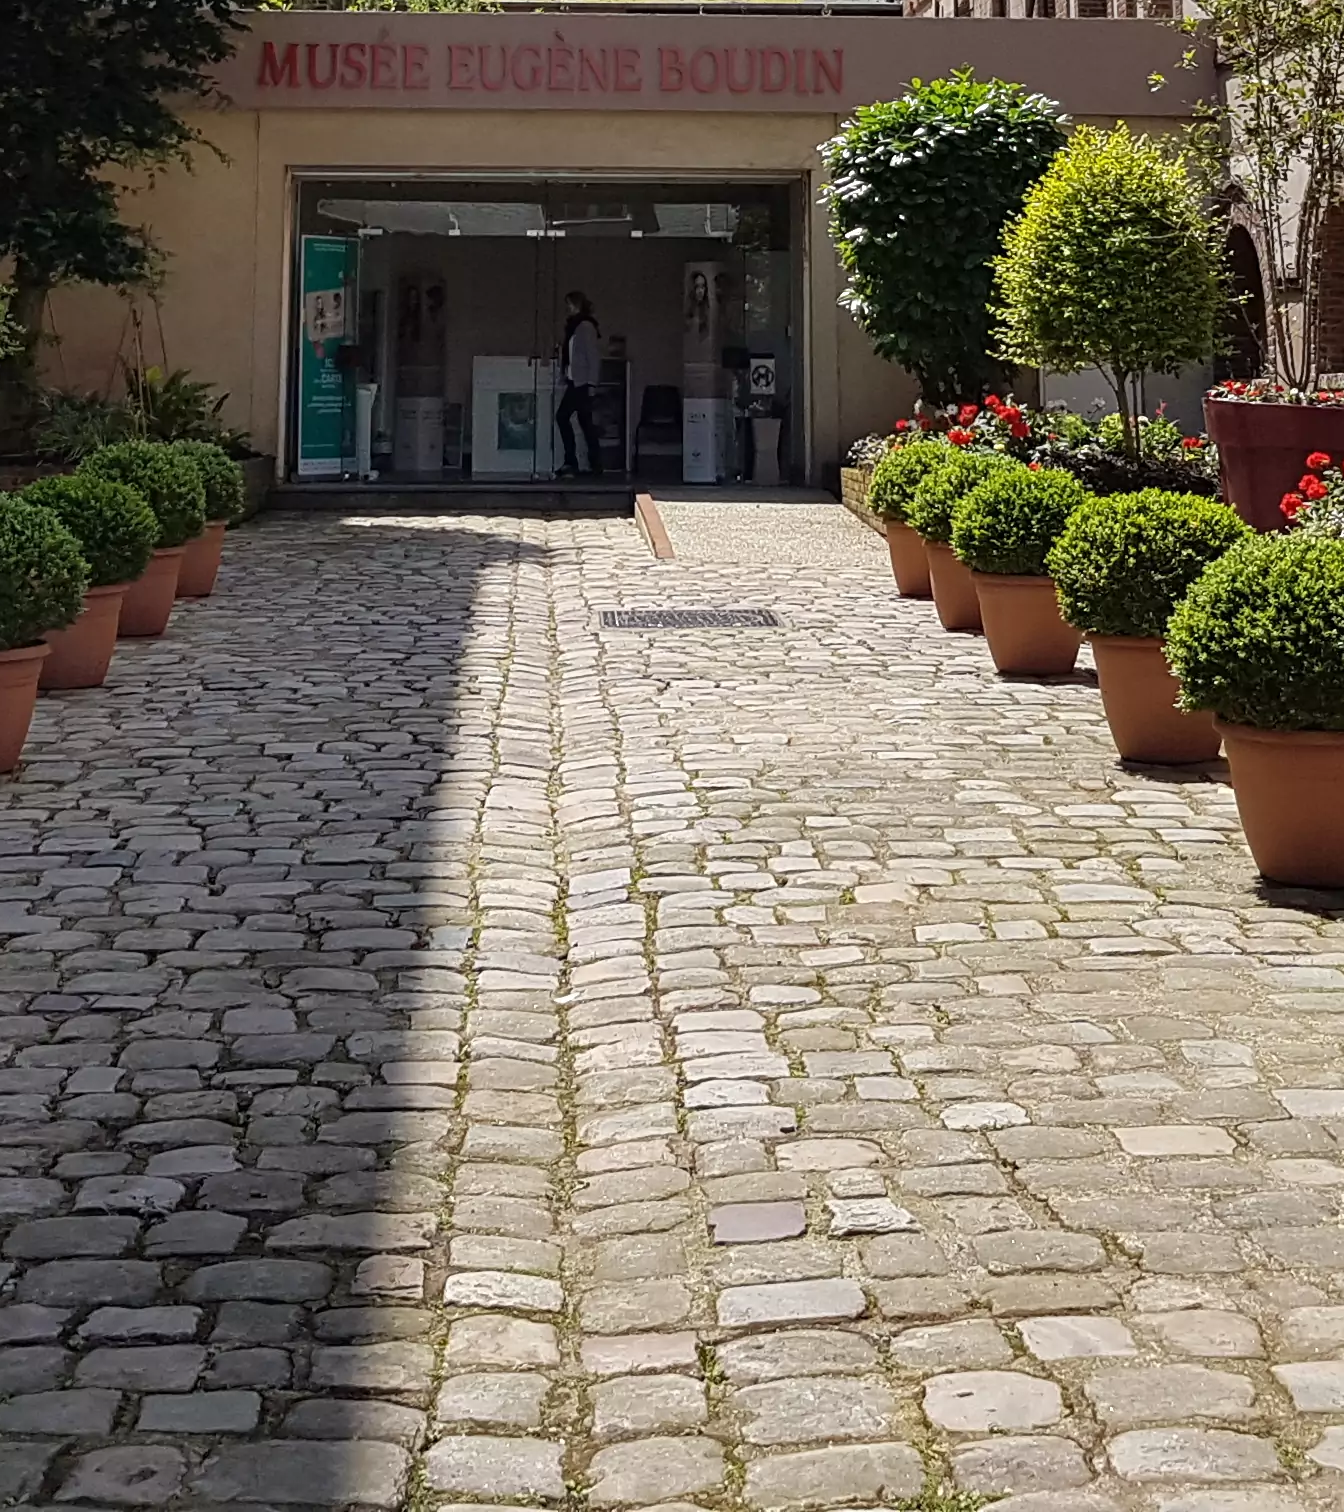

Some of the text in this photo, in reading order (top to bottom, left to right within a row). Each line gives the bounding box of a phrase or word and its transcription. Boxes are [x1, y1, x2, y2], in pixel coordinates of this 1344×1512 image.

[258, 27, 844, 96] MUSÉE EUGÈNE BOUDIN
